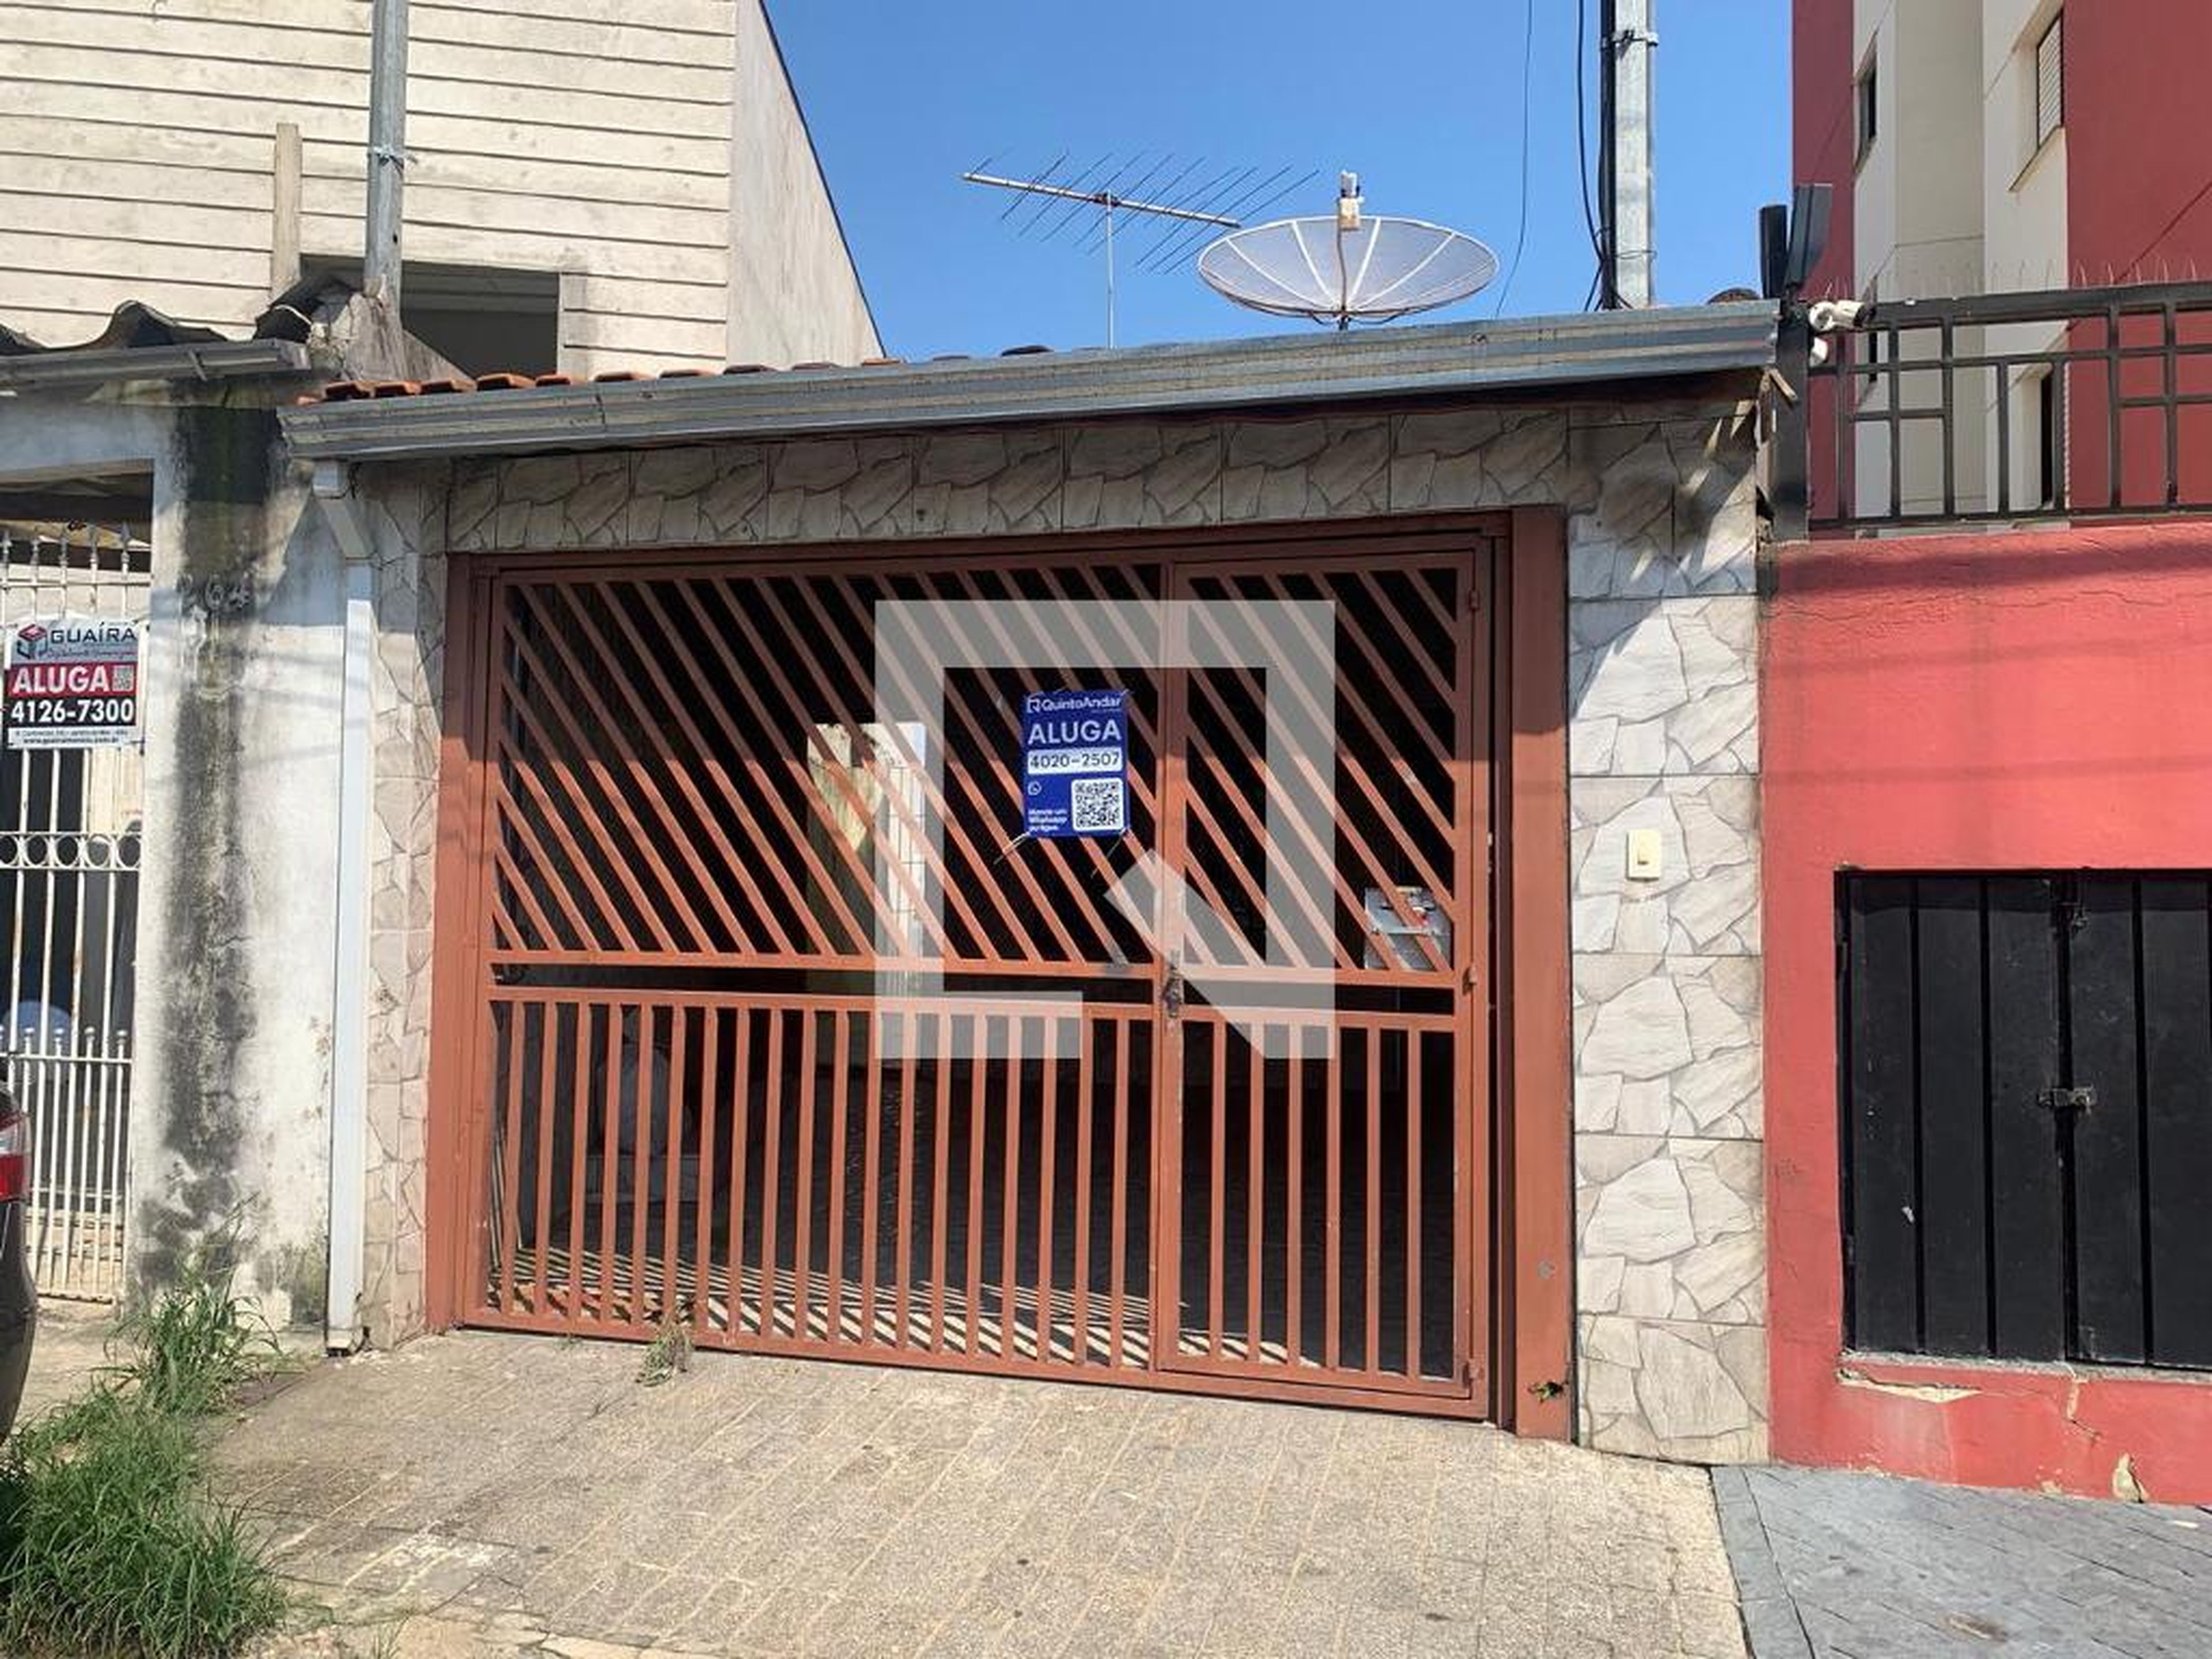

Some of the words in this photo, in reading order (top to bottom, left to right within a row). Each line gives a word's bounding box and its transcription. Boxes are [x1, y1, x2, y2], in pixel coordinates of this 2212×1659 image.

[51, 622, 137, 643] GUAÍRA
[13, 665, 109, 694] ALUGA
[11, 699, 134, 722] 4126-7300
[1041, 698, 1121, 711] QuintoAndar
[1028, 719, 1122, 744] ALUGA
[1031, 752, 1120, 768] 4020-2507
